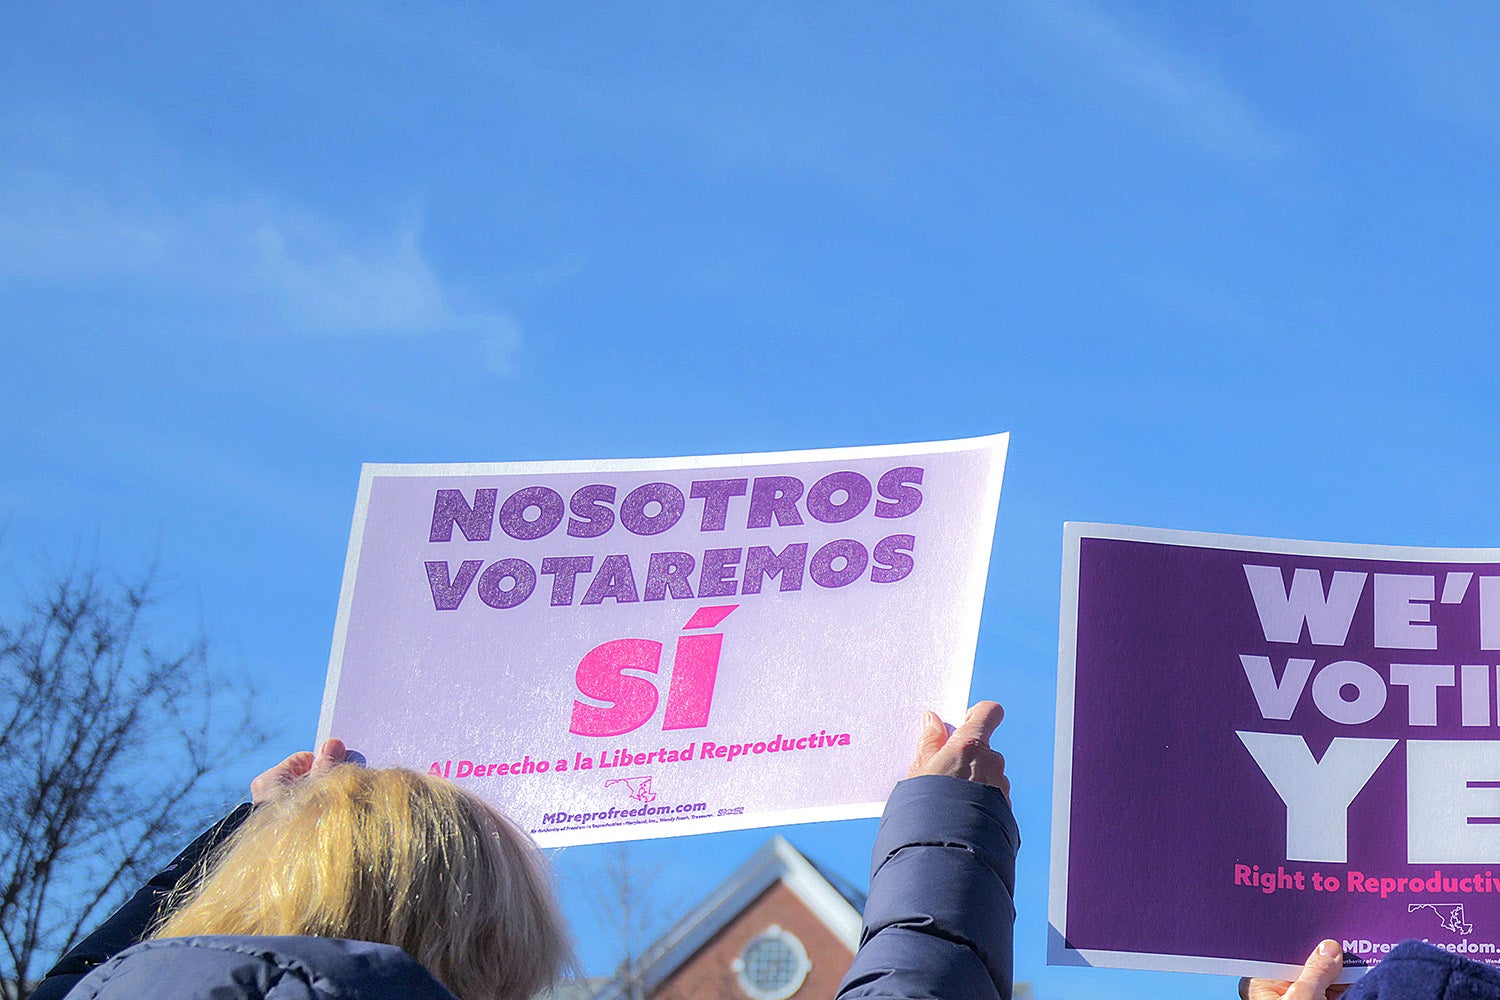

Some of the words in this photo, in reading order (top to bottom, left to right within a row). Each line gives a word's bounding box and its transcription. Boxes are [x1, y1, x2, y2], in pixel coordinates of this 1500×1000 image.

[428, 467, 925, 542] NOSOTROS
[423, 534, 916, 611] VOTAREMOS
[428, 760, 452, 779] Al
[456, 755, 551, 779] Derecho
[554, 759, 568, 773] a
[573, 752, 594, 771] la
[598, 742, 696, 769] Libertad
[699, 730, 851, 762] Reproductiva
[542, 802, 707, 824] MDreprofreedom.com
[1234, 864, 1305, 894] Right
[1311, 872, 1341, 893] to
